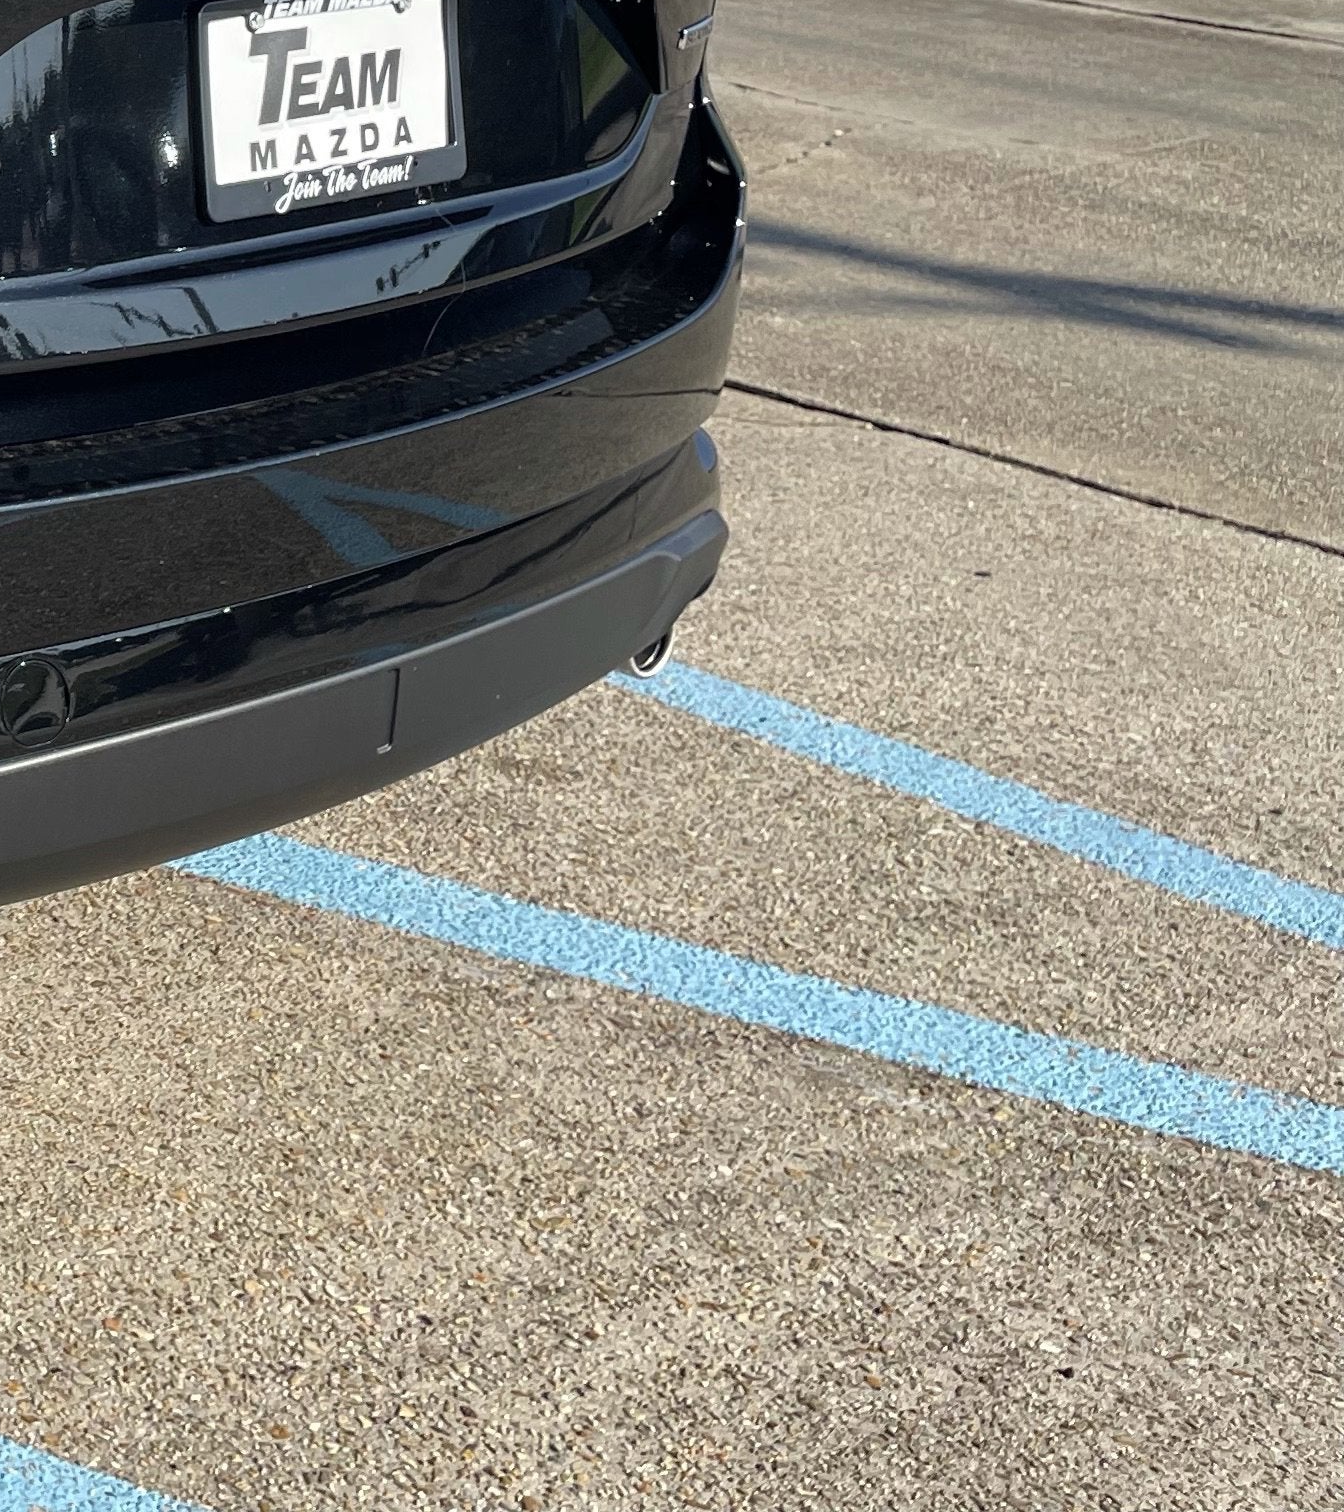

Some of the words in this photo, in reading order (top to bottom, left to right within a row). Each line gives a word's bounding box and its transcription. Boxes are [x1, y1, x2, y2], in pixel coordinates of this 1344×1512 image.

[248, 26, 402, 126] TEAM
[250, 116, 413, 172] MAZDA
[275, 172, 323, 214] Join
[321, 165, 358, 196] The
[360, 155, 413, 188] Team!
